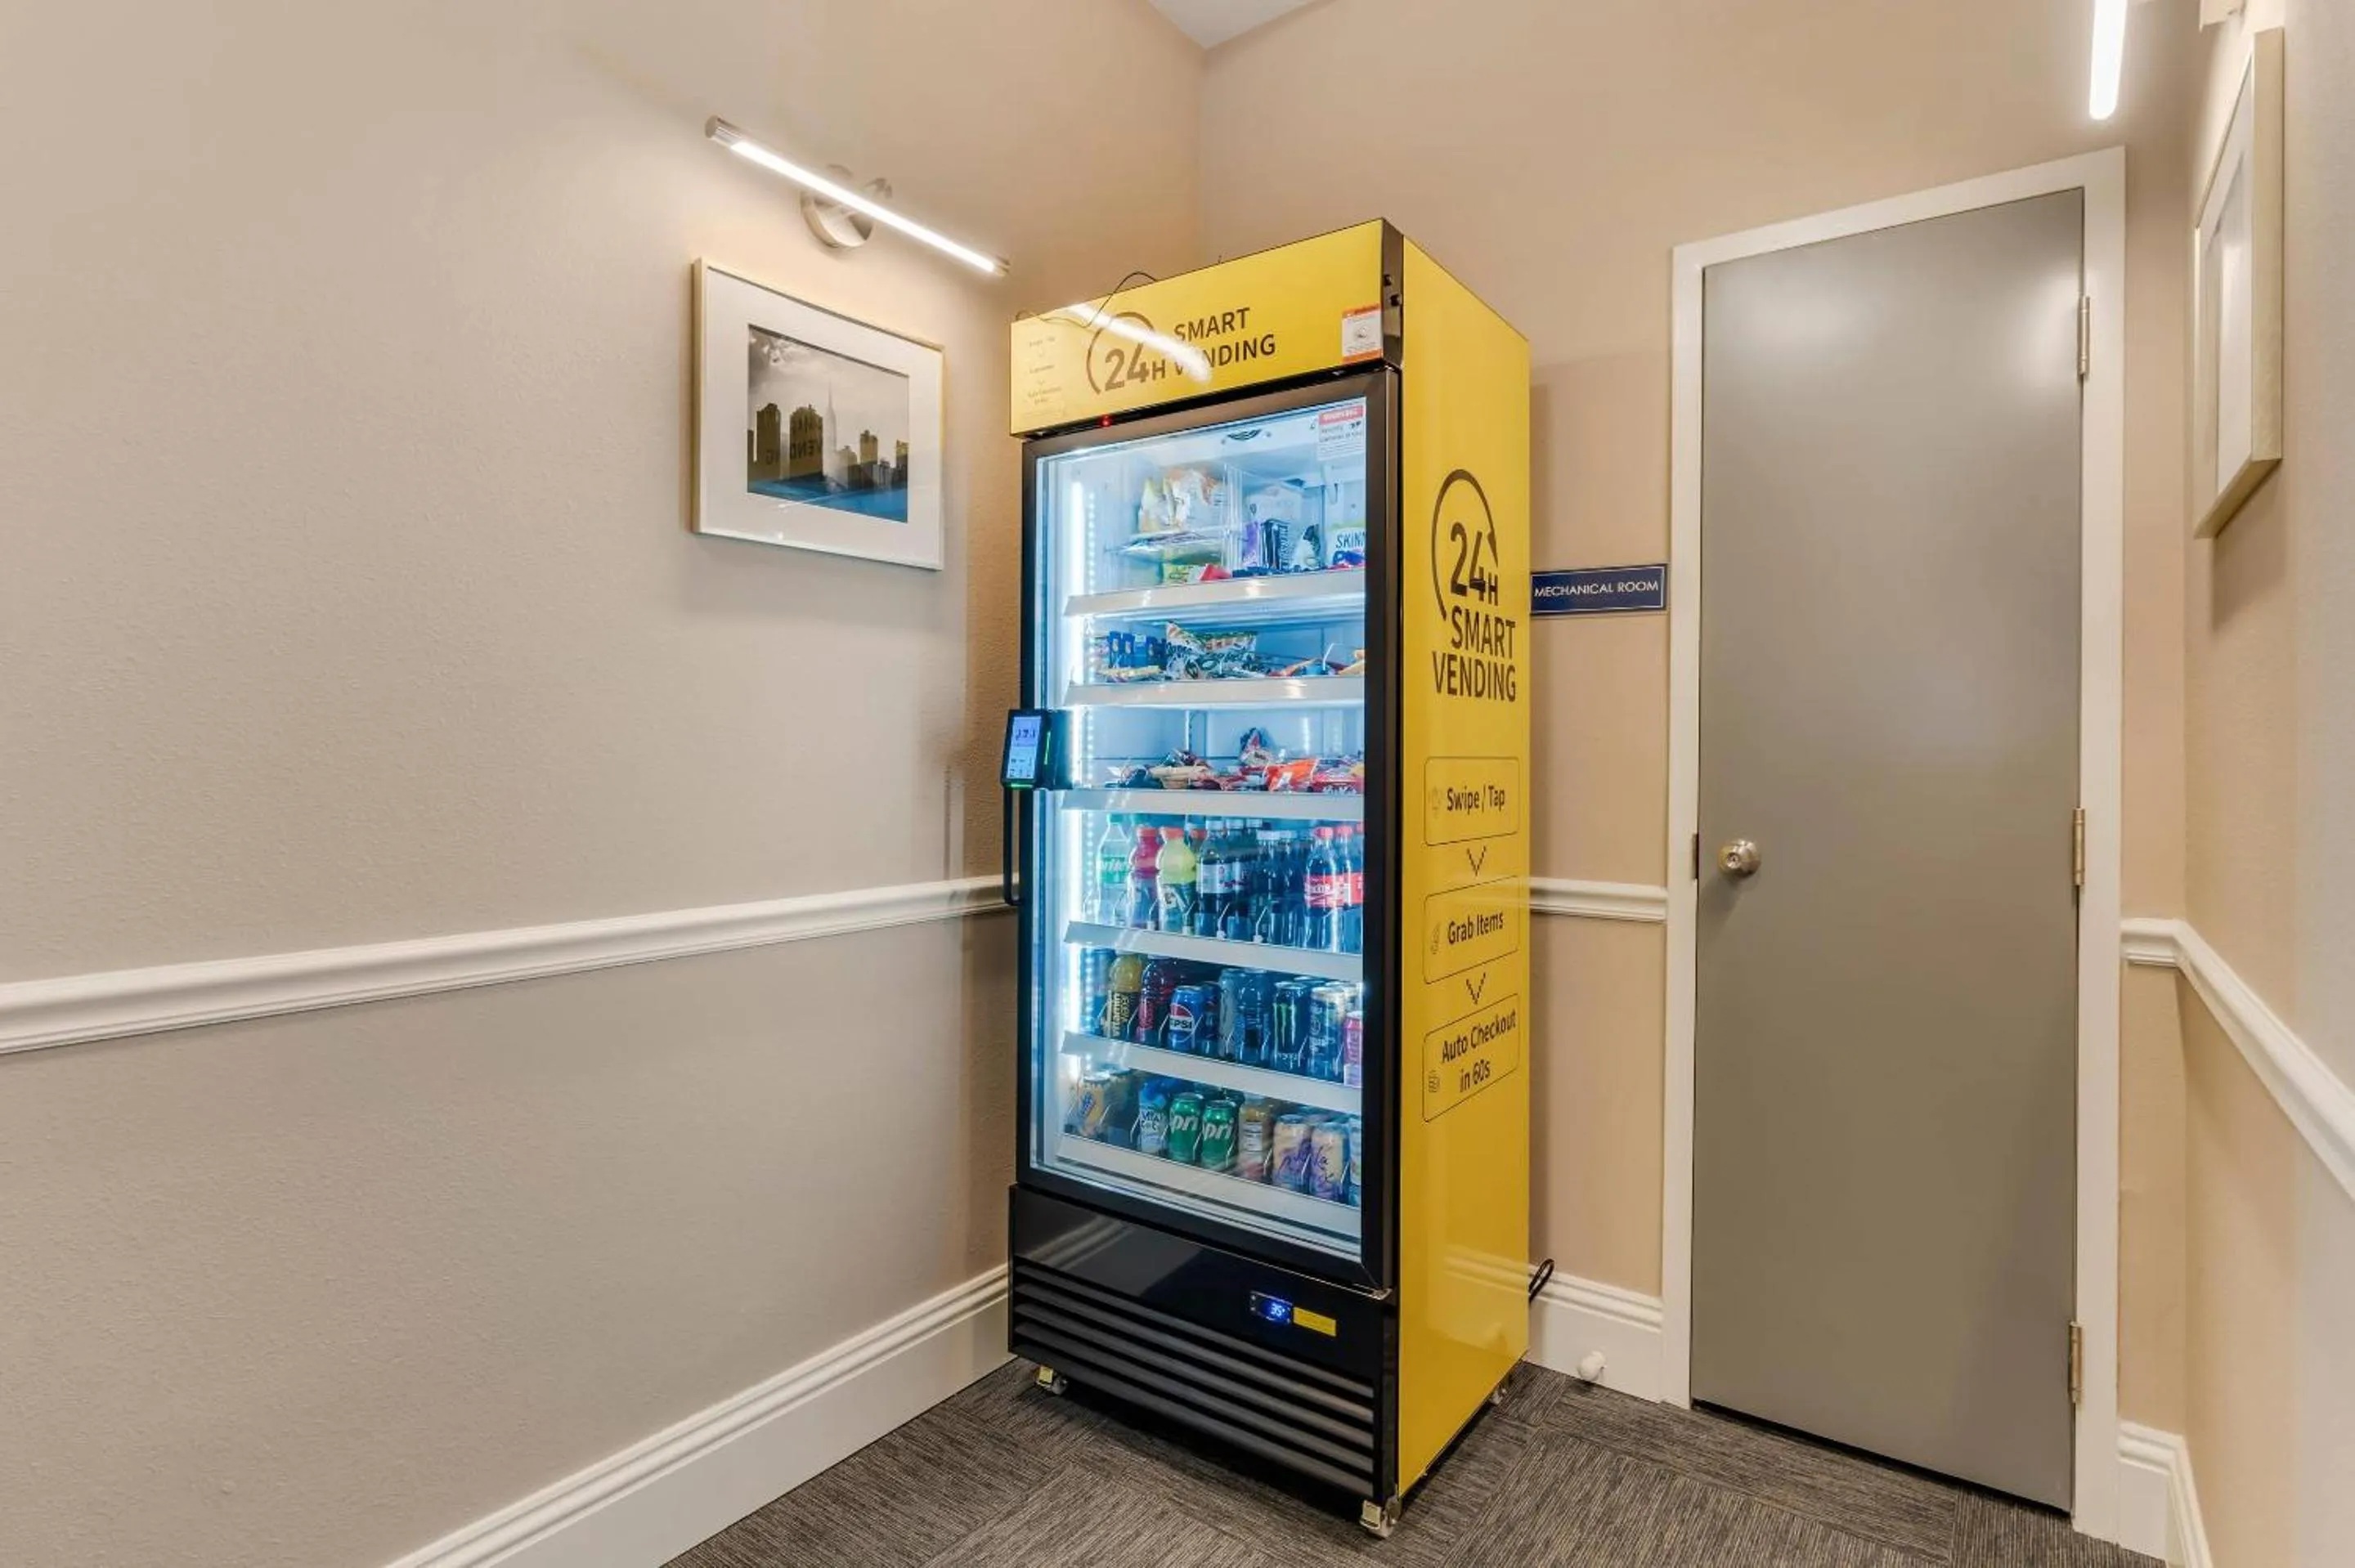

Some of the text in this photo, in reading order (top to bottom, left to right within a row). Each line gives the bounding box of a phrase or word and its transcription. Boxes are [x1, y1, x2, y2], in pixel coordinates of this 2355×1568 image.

[1173, 307, 1250, 342] SMART
[1174, 334, 1276, 376] VNDING
[1534, 580, 1659, 598] MECHANICAL ROOM
[1451, 605, 1516, 659] SMART
[1432, 651, 1516, 703] VENDING
[1447, 786, 1480, 816] Swipe
[1487, 785, 1505, 813] Tap
[1448, 912, 1504, 945] Grab Items
[1442, 1008, 1517, 1064] Auto Checkout
[1460, 1059, 1491, 1093] in 60s
